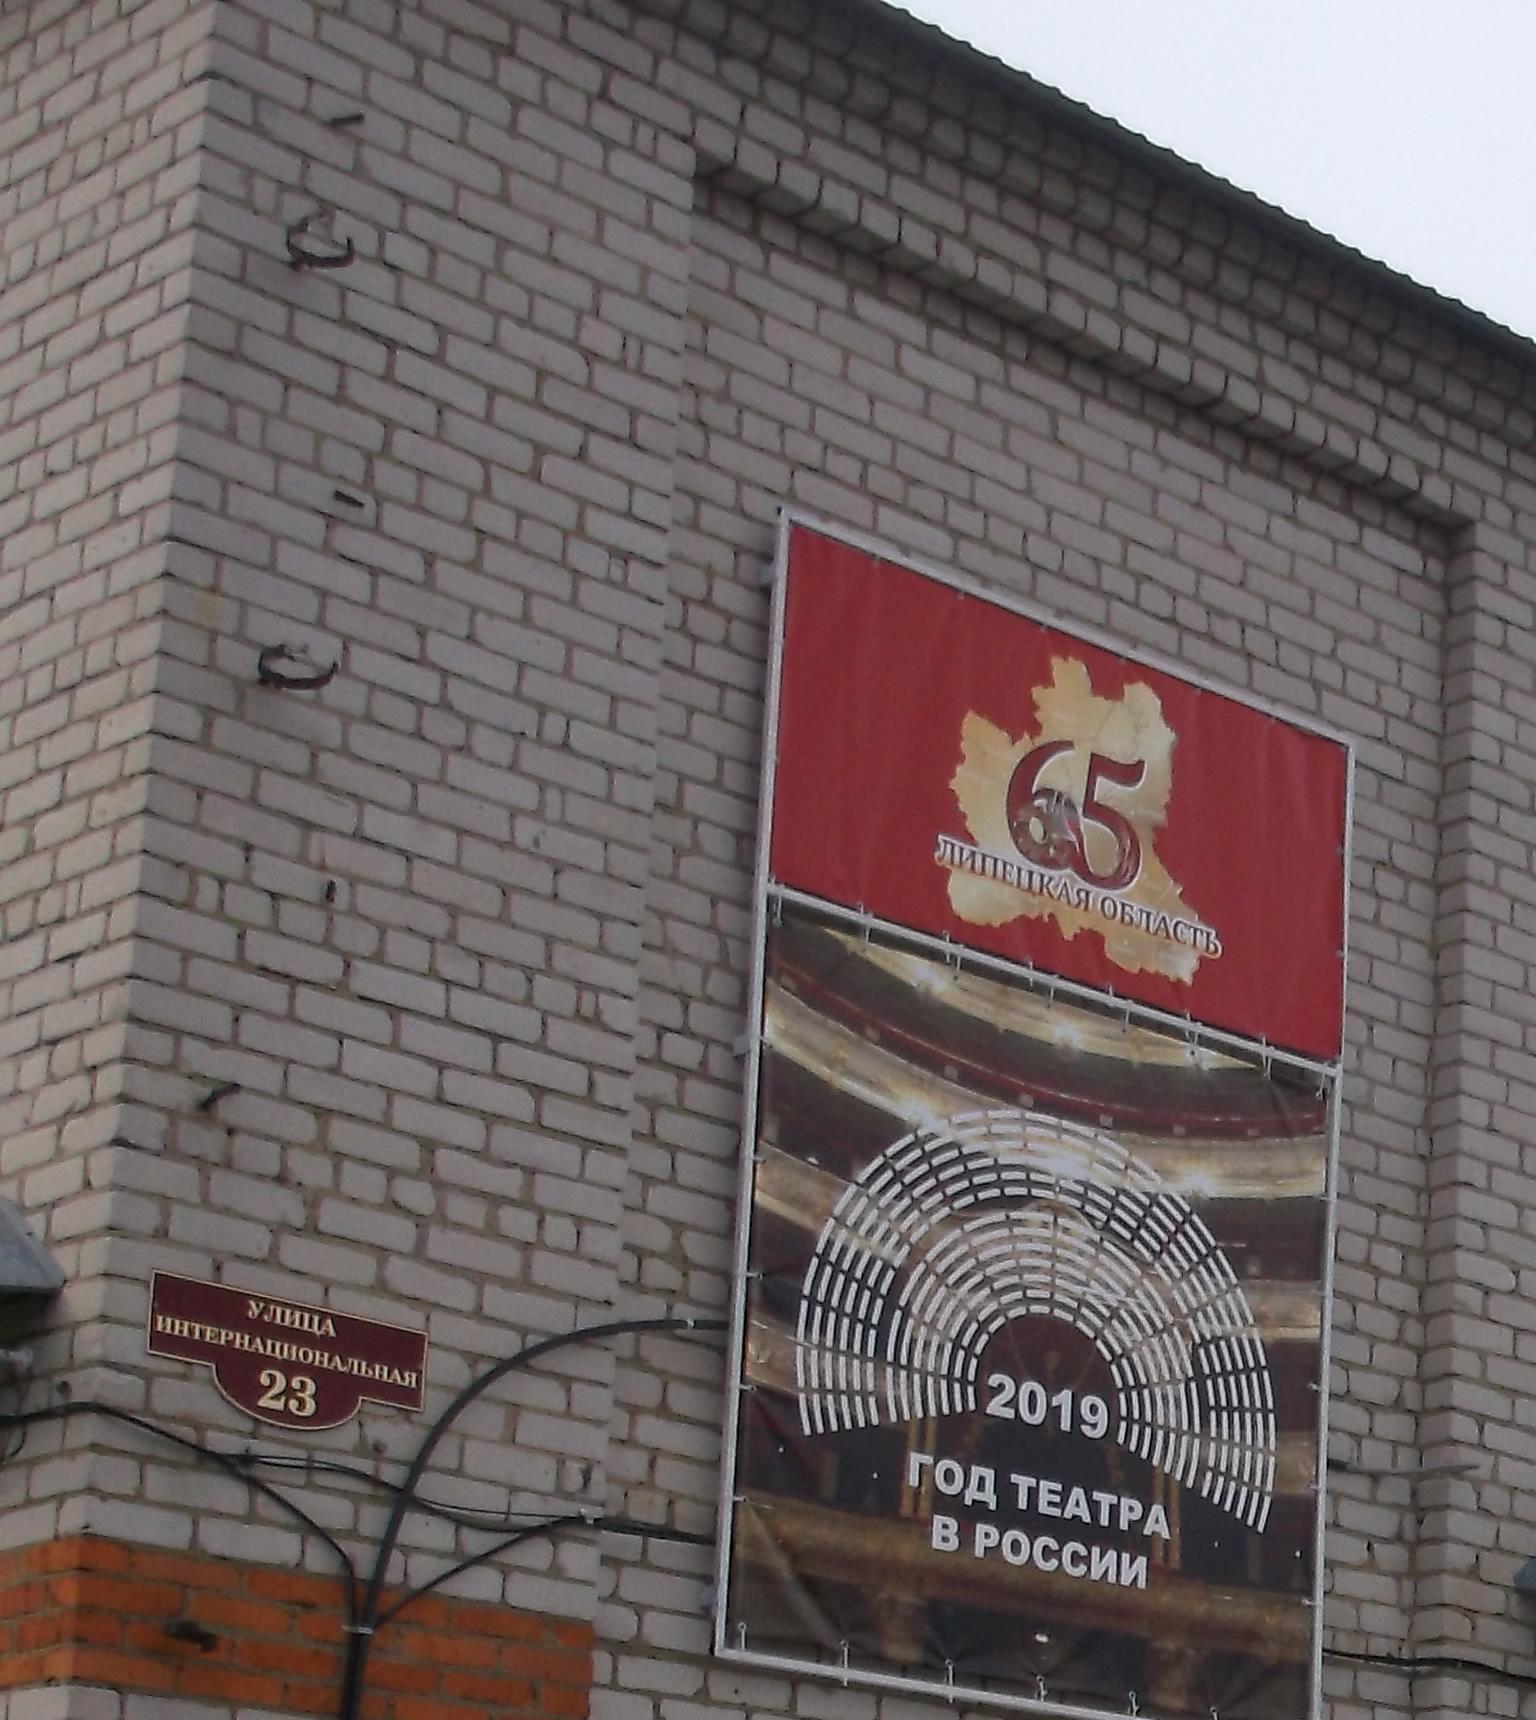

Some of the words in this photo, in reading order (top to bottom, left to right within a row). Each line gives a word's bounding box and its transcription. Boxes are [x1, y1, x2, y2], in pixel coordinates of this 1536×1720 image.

[1006, 739, 1145, 892] 65
[939, 840, 1092, 908] ЛИПЕЦКАЯ
[1099, 895, 1222, 955] ОБЛАСТЬ
[155, 1315, 419, 1389] ИНТЕРНАЦИОНАЛЬНАЯ
[248, 1299, 338, 1338] УЛИЦА
[256, 1368, 317, 1418] 23
[984, 1373, 1109, 1439] 2019
[908, 1451, 997, 1511] ГОД
[1010, 1473, 1171, 1540] ТЕАТРА
[931, 1514, 960, 1552] В
[974, 1522, 1148, 1590] РОССИИ
